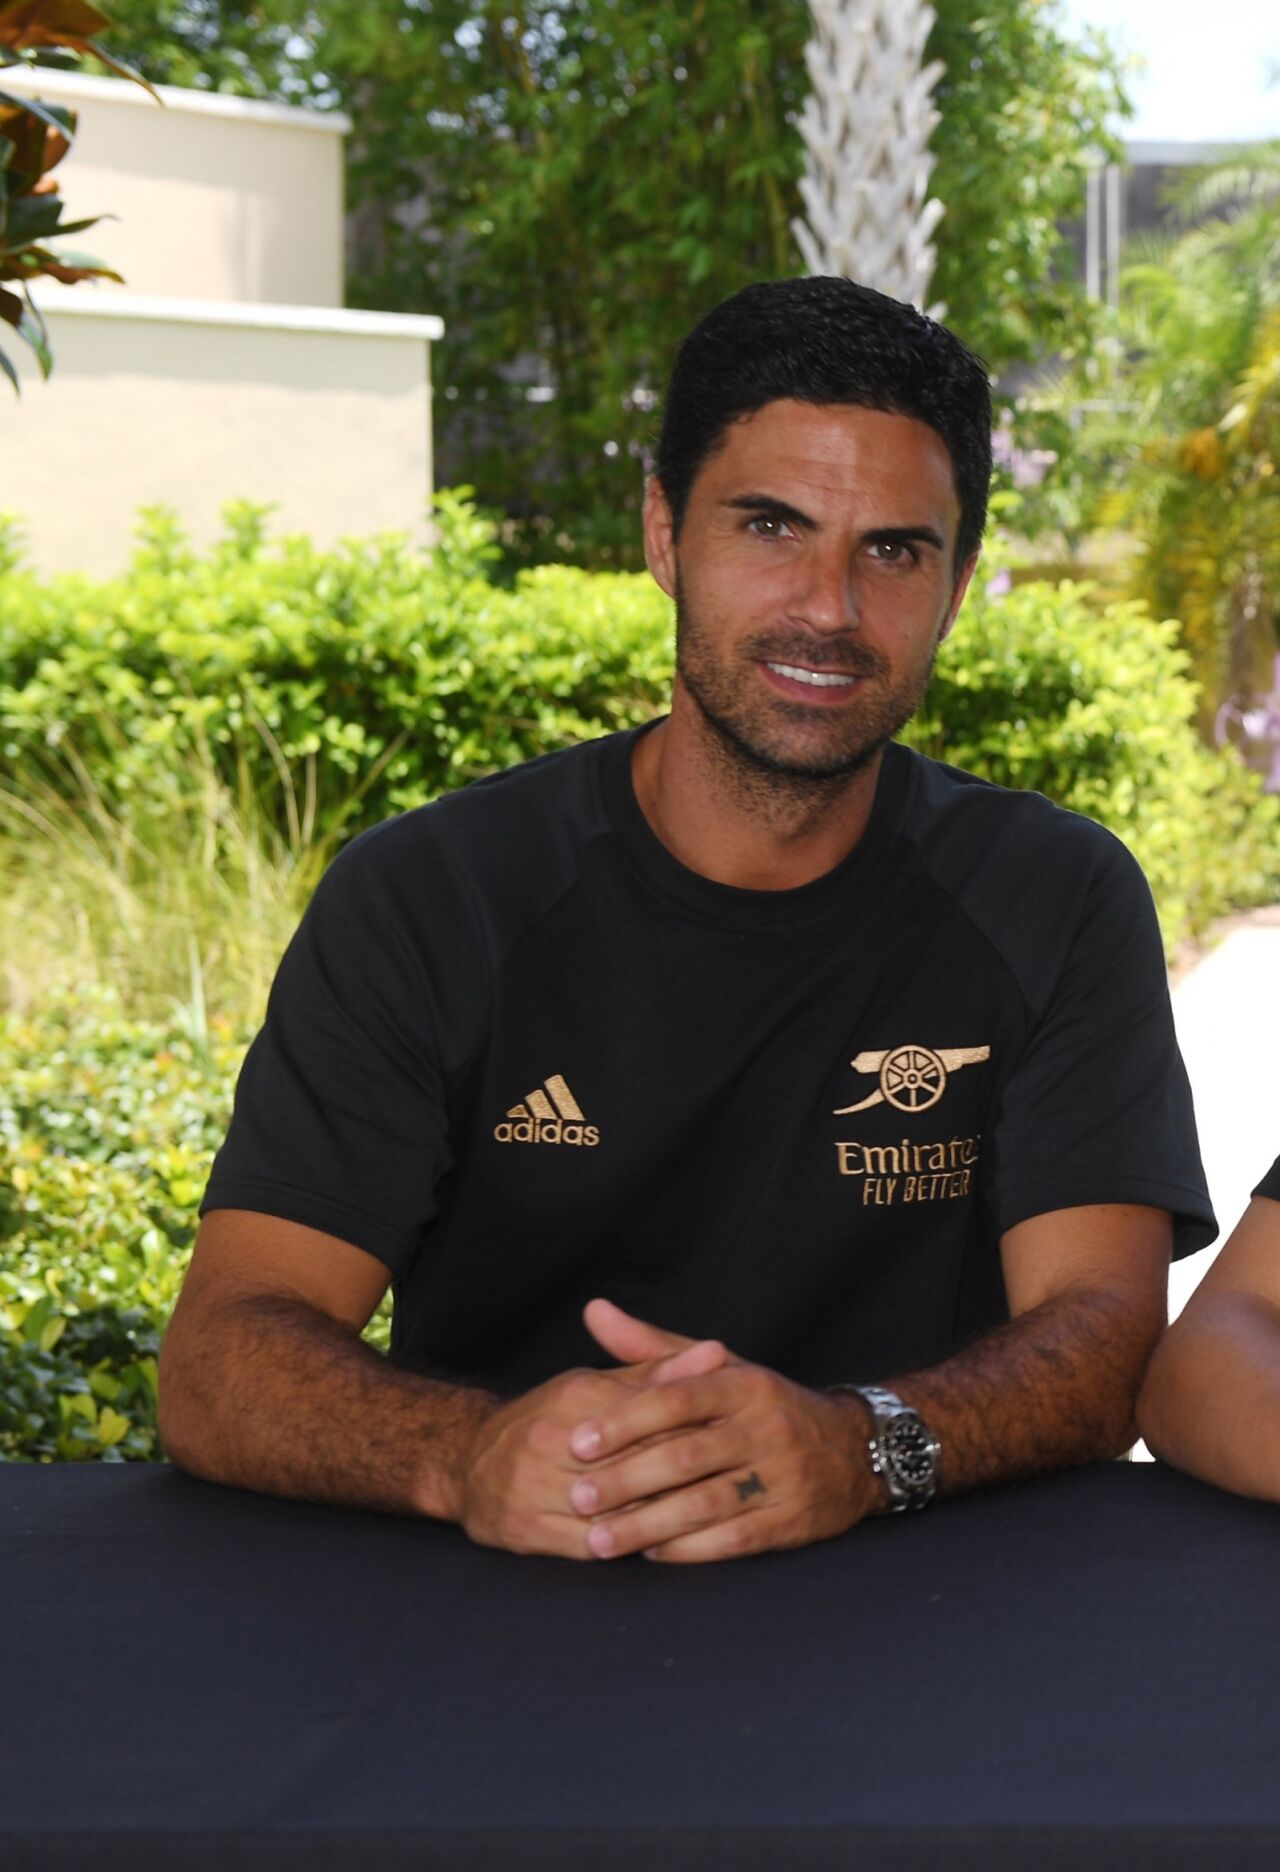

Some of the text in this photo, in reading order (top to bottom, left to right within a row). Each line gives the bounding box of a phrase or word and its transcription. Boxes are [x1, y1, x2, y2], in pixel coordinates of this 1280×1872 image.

[494, 1117, 600, 1146] adidas
[834, 1134, 981, 1175] Emirate
[863, 1169, 971, 1206] FLY BETTER
